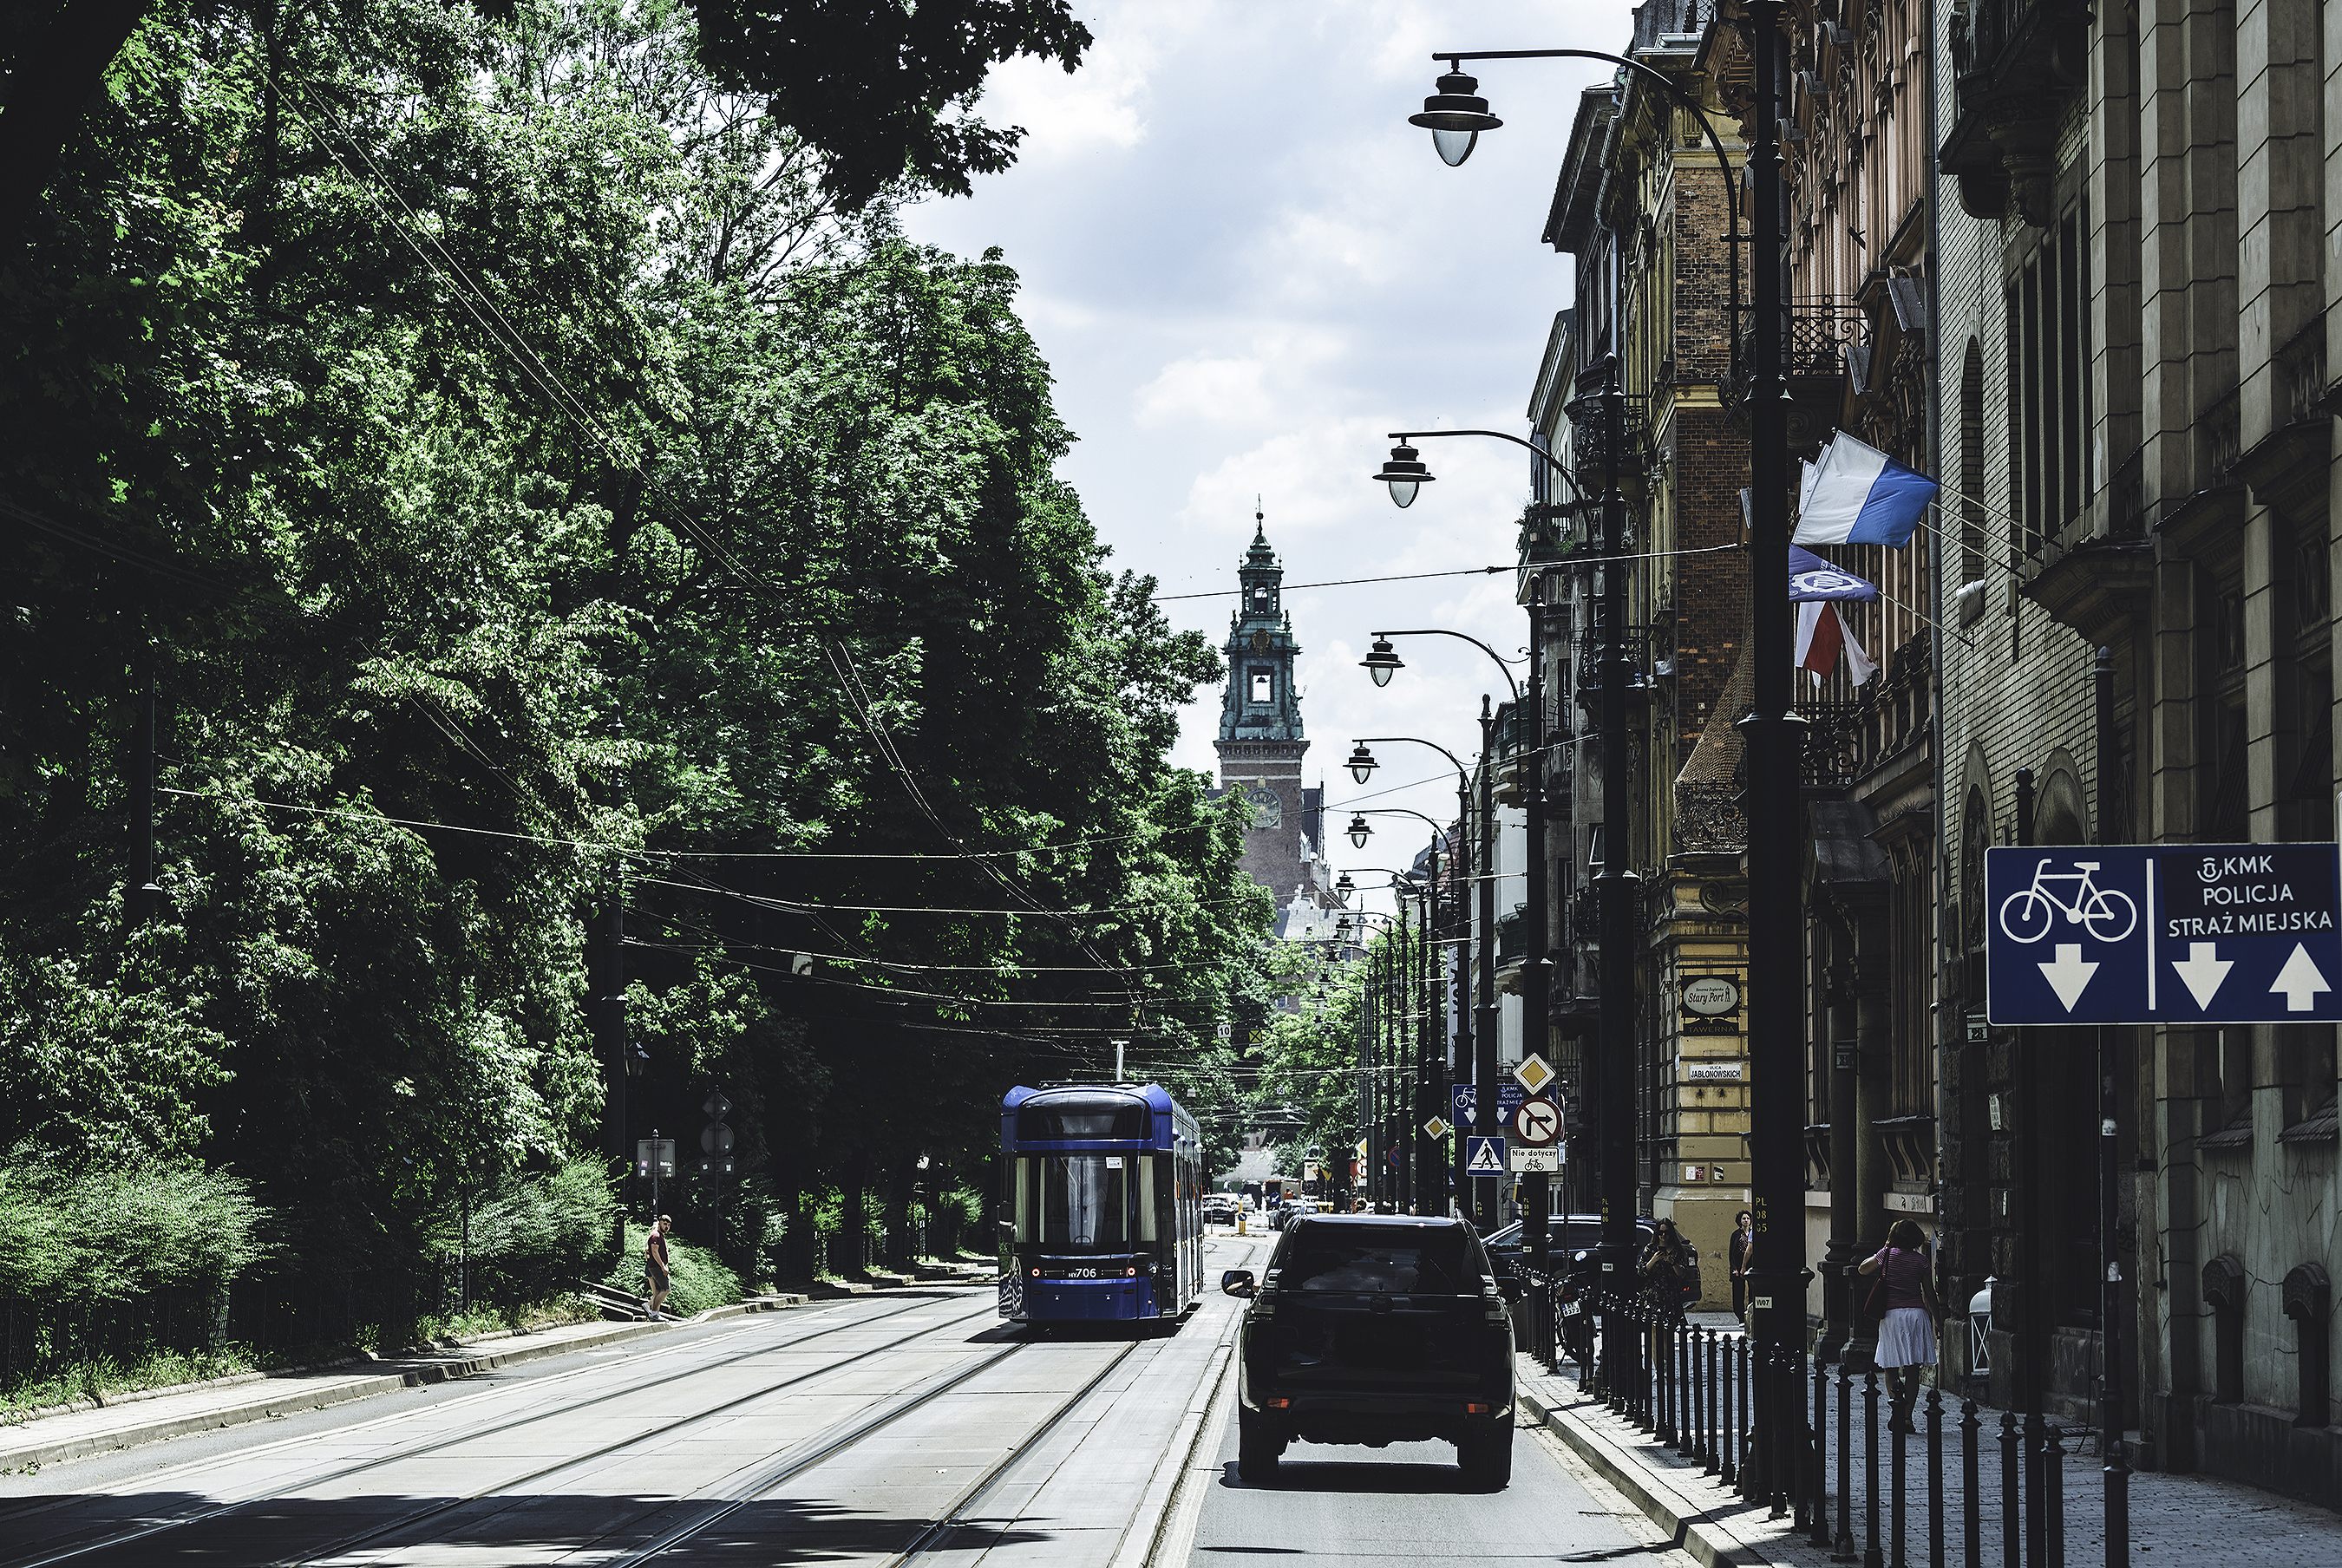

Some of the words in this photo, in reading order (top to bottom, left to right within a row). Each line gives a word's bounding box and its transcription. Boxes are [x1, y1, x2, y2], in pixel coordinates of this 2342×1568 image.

[2224, 855, 2273, 874] KMK
[2203, 884, 2294, 905] POLICJA
[2169, 911, 2234, 938] STRAŻ
[2238, 911, 2333, 932] MIEJSKA
[1688, 992, 1707, 1005] Stary
[1709, 992, 1724, 1002] Port
[1219, 1027, 1230, 1036] 10
[1971, 1028, 1984, 1040] 28
[1528, 1149, 1557, 1159] dotyczy
[1756, 1197, 1768, 1206] PL
